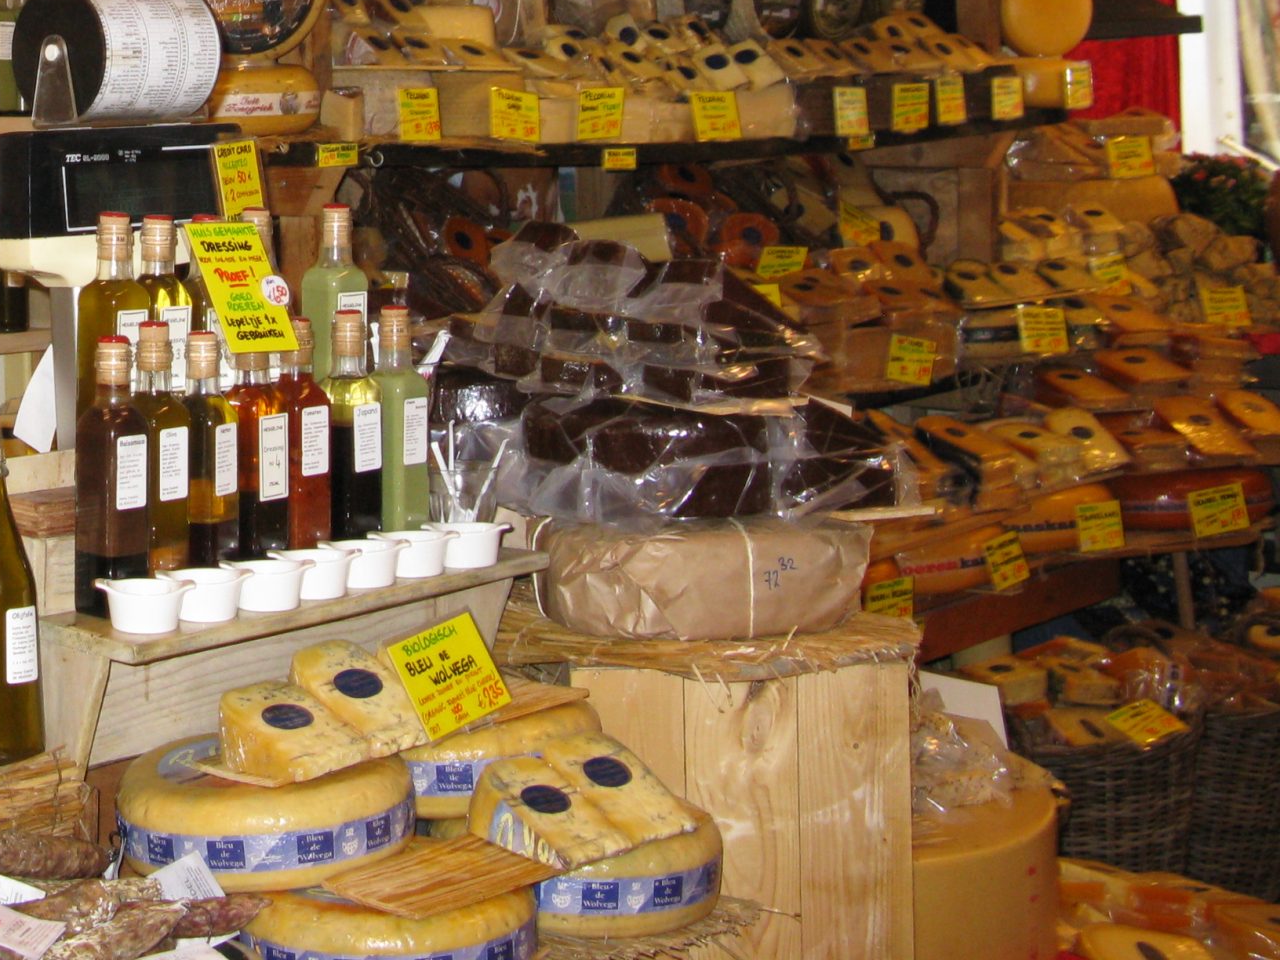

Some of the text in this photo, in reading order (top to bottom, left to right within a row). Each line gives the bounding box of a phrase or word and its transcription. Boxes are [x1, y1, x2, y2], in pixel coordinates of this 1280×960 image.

[65, 153, 81, 163] TEC
[200, 237, 253, 253] DRESSING
[404, 649, 451, 677] BLEU DE
[428, 654, 478, 687] WOLVEGA
[215, 840, 234, 849] Bleu
